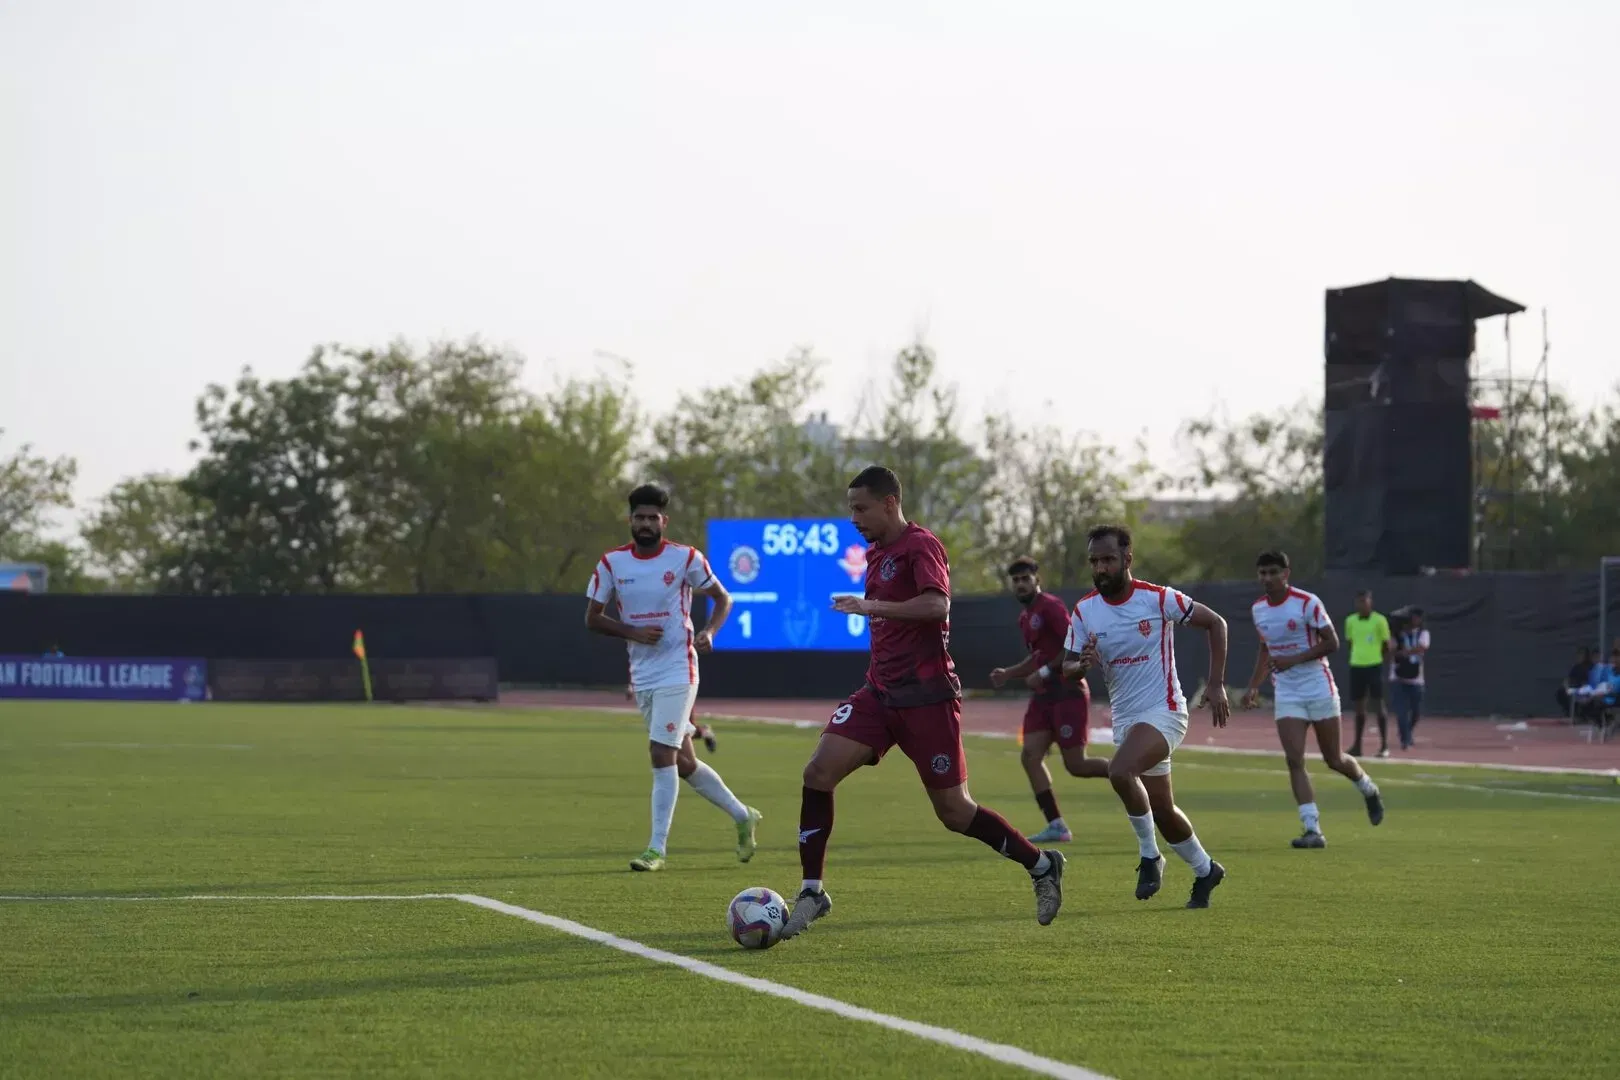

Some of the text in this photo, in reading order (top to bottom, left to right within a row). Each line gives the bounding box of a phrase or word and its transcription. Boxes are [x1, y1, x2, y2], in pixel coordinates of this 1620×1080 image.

[763, 523, 839, 556] 56:43
[738, 610, 752, 639] 1
[847, 613, 866, 638] 0
[21, 663, 104, 687] FOOTBALL
[109, 664, 173, 689] LEAGUE
[832, 703, 853, 724] 9
